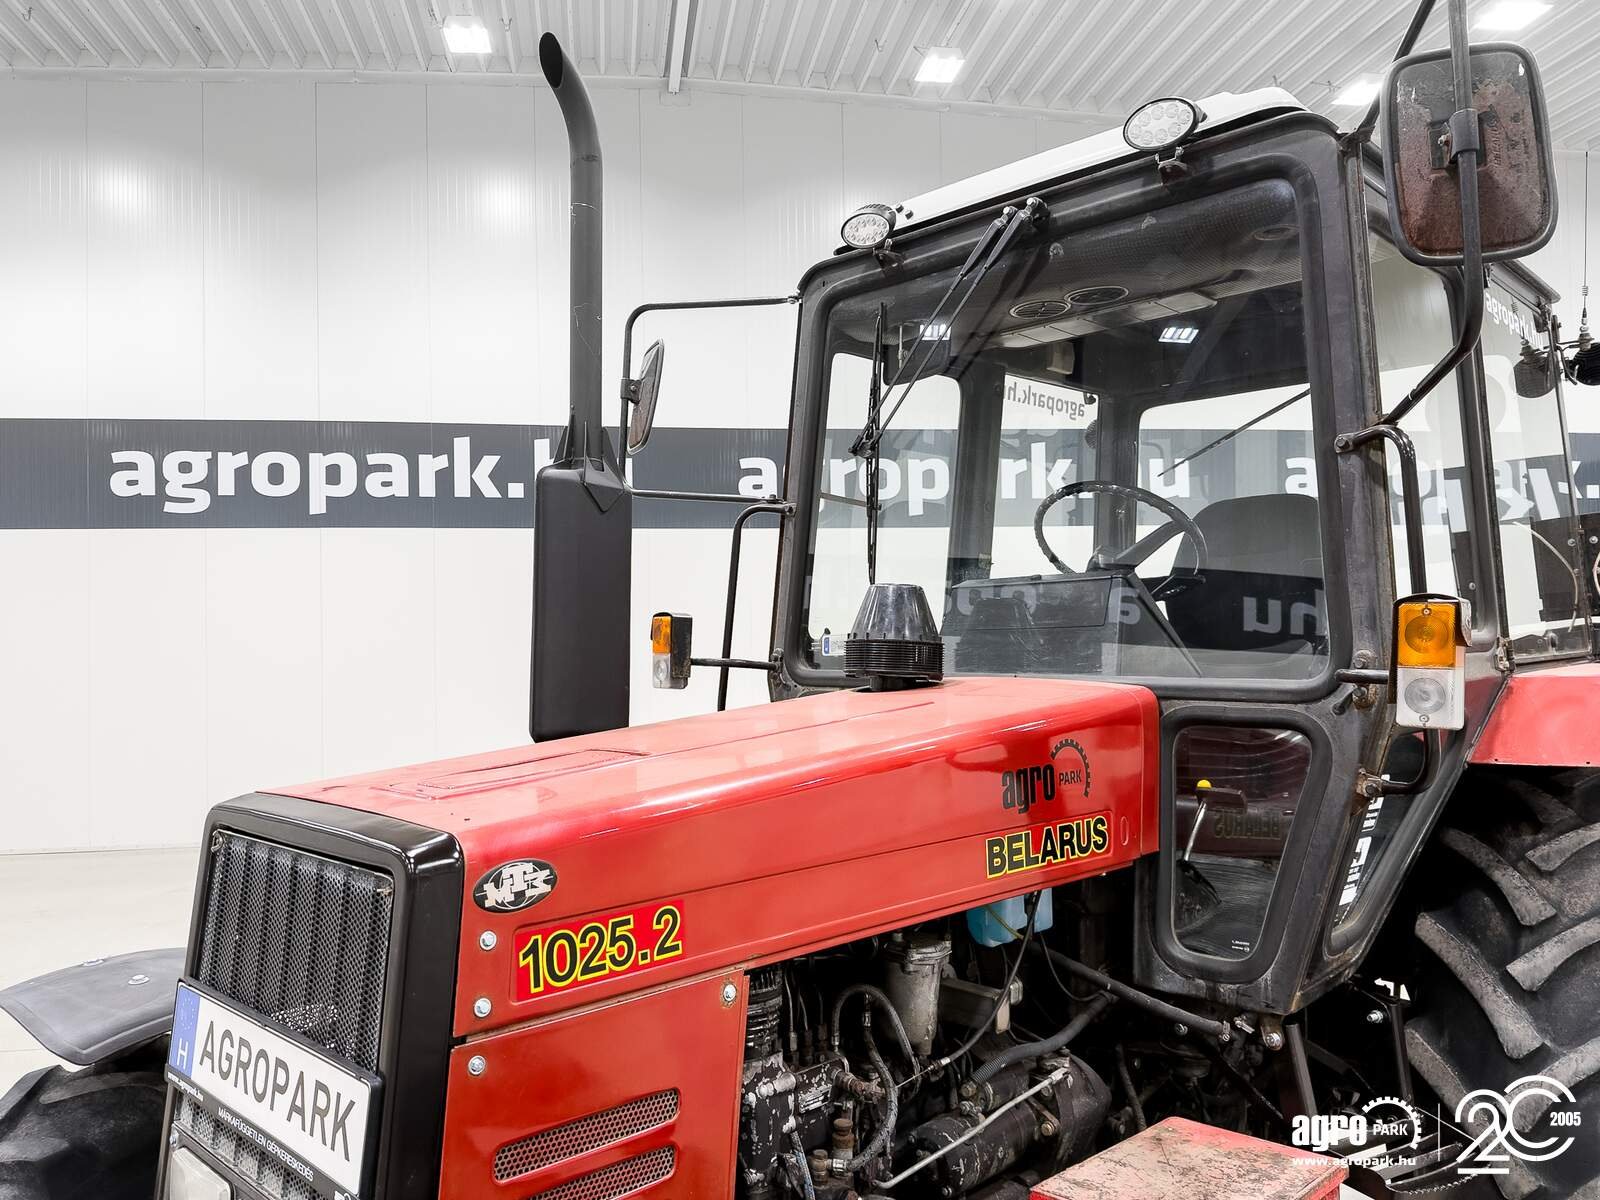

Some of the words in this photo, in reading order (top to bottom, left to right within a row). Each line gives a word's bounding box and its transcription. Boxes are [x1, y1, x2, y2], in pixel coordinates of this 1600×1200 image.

[109, 436, 633, 515] agropark.
[1001, 763, 1056, 814] agro
[1058, 769, 1082, 787] PARK
[985, 815, 1109, 879] BELARUS
[518, 905, 683, 994] 1025.2
[176, 1037, 190, 1071] H
[199, 1020, 357, 1163] AGROPARK
